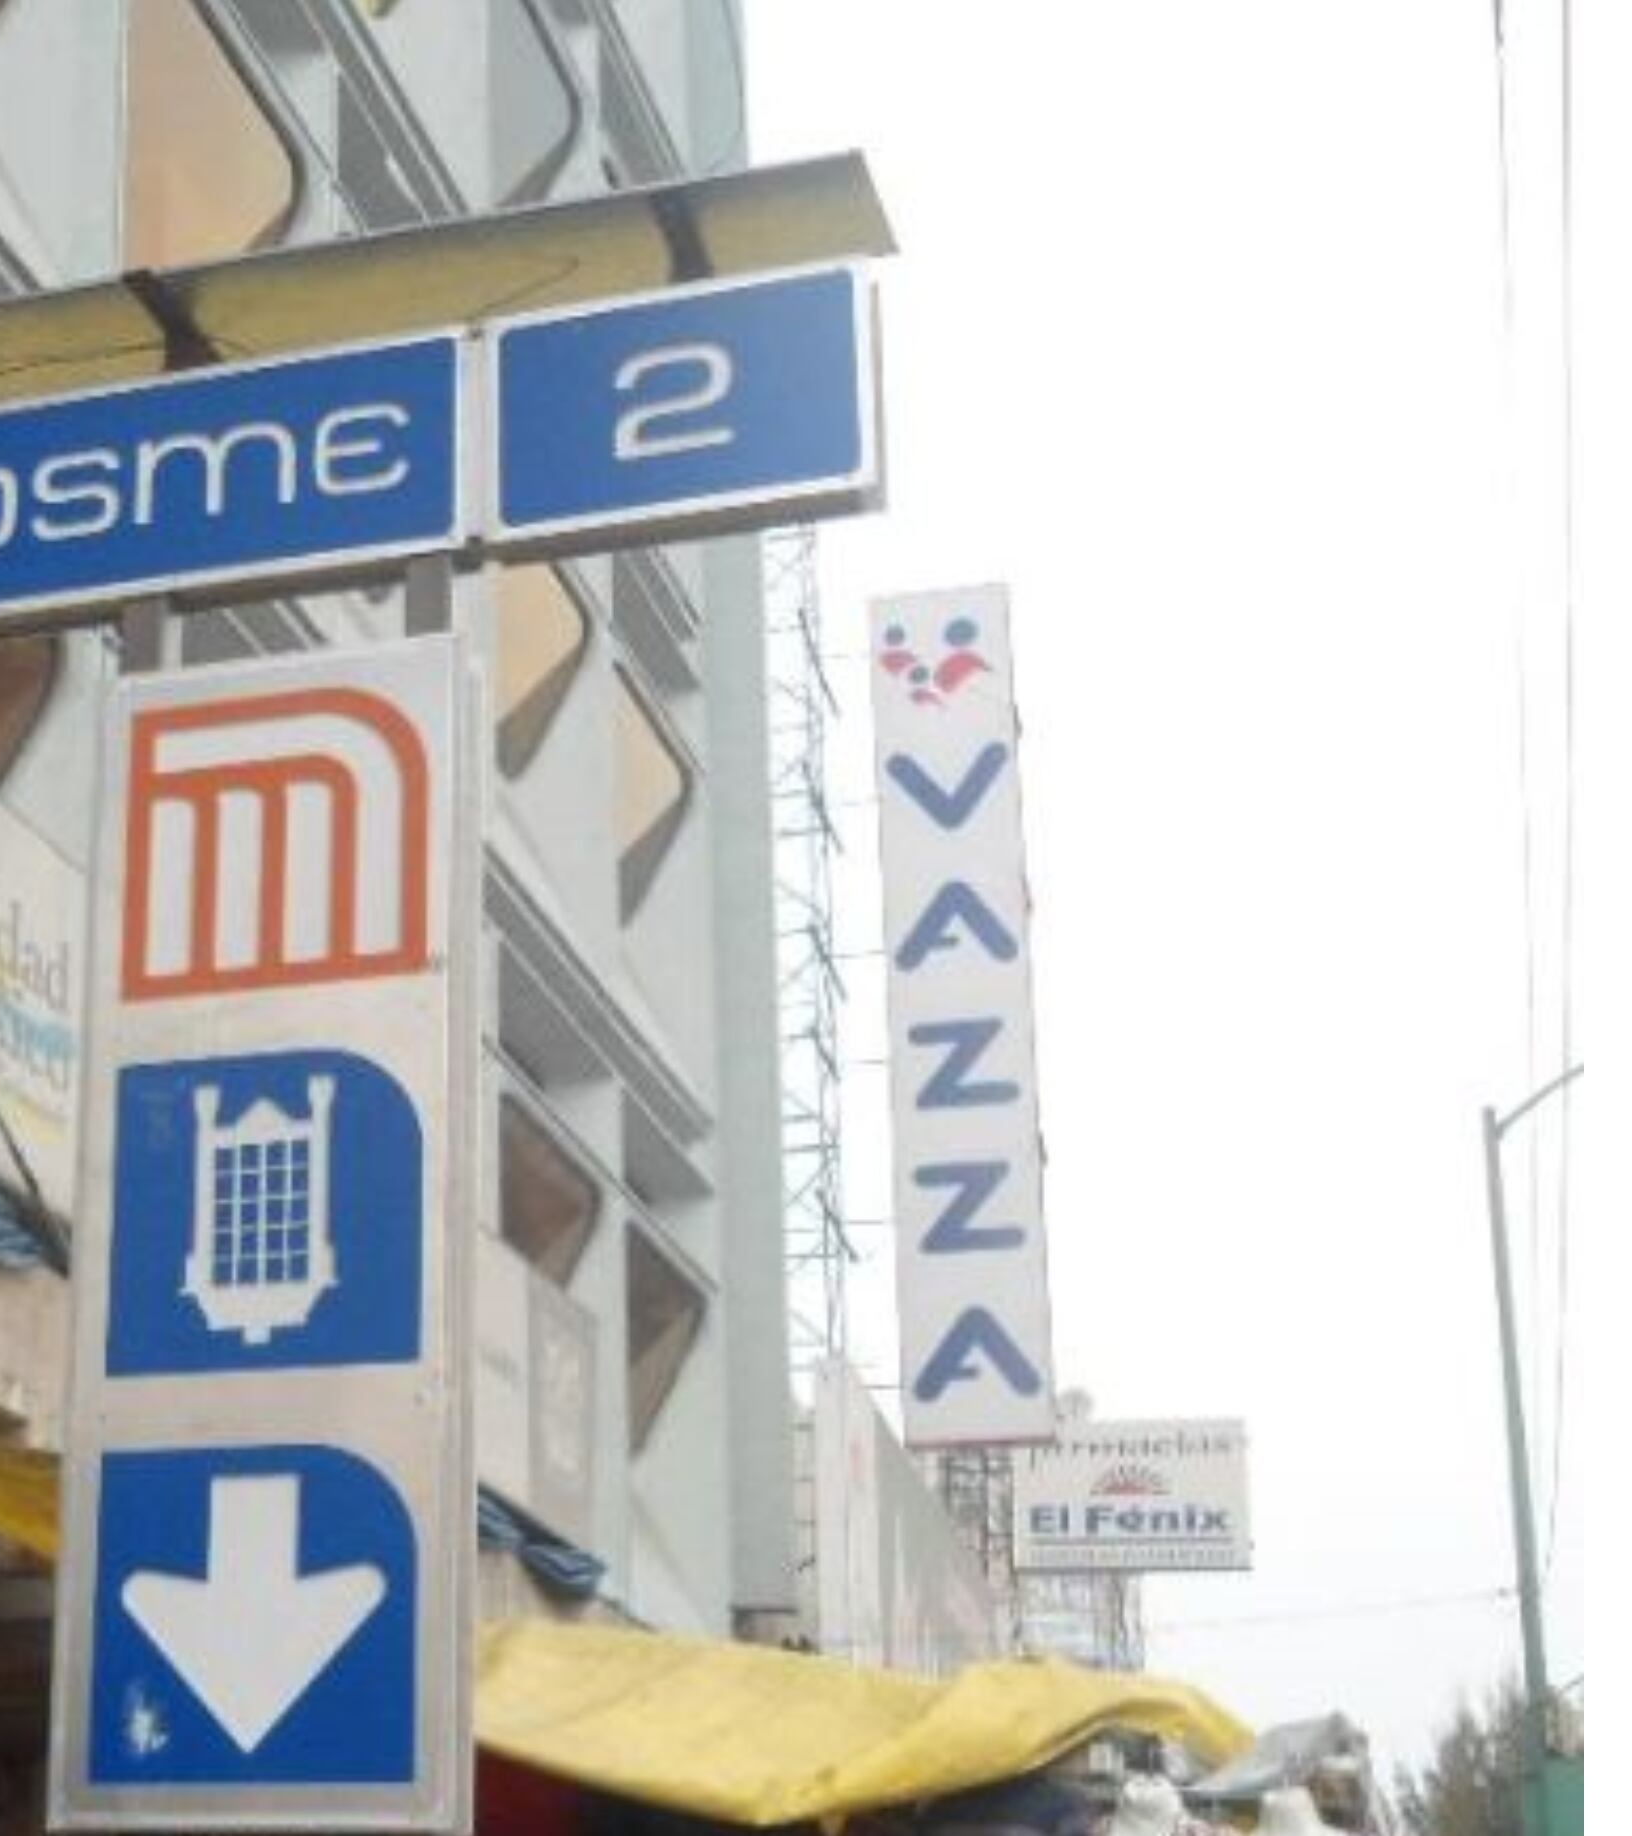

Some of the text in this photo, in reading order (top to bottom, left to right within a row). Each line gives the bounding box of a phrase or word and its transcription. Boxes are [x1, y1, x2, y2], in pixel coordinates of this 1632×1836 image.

[613, 342, 735, 460] 2
[885, 742, 1042, 1401] VAZZA
[1029, 1503, 1069, 1534] El
